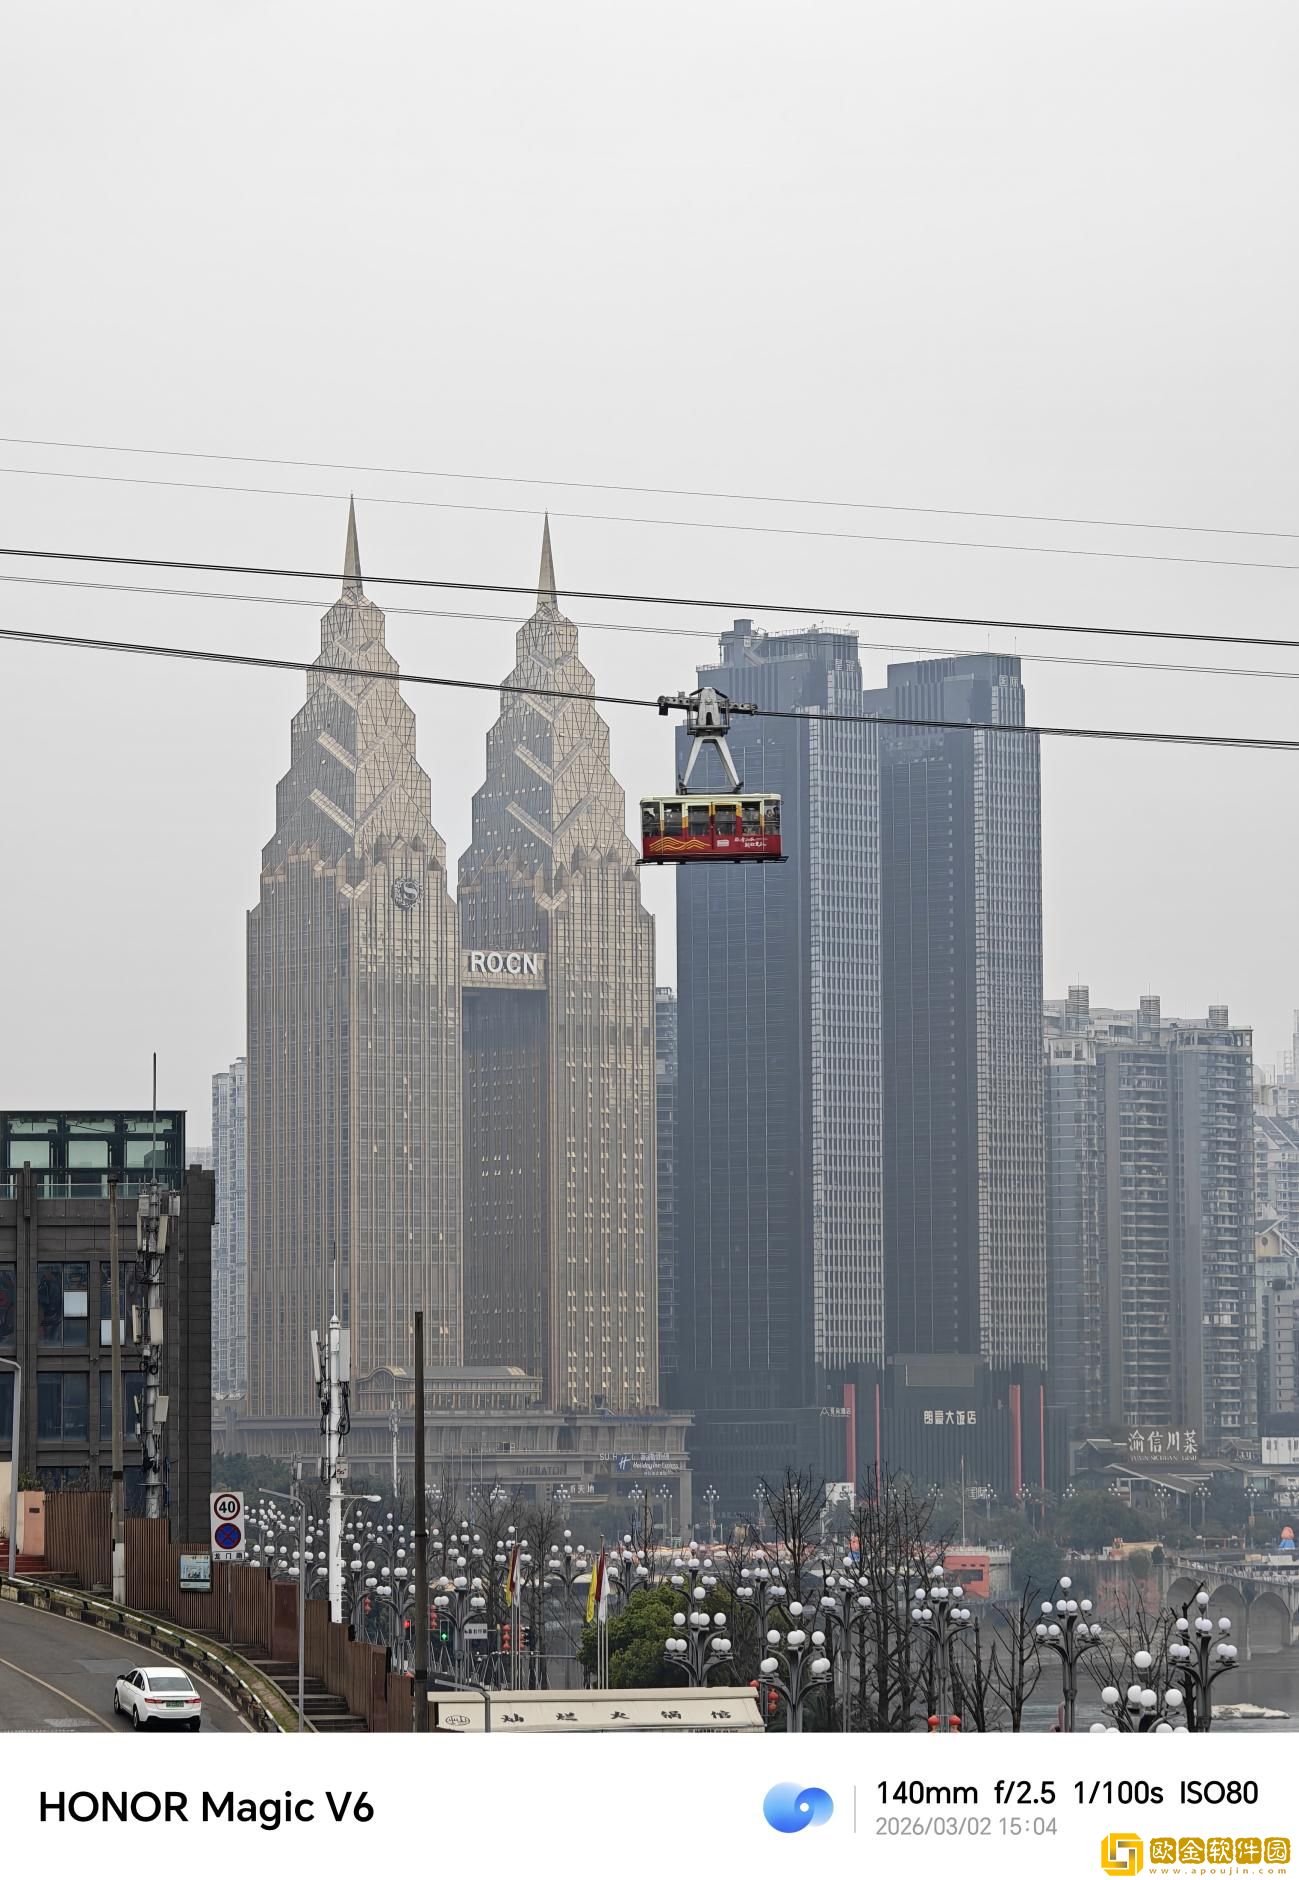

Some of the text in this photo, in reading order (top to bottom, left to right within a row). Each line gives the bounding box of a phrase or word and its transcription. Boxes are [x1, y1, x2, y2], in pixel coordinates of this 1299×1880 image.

[1128, 1429, 1198, 1454] 渝信川菜
[219, 1501, 236, 1514] 40
